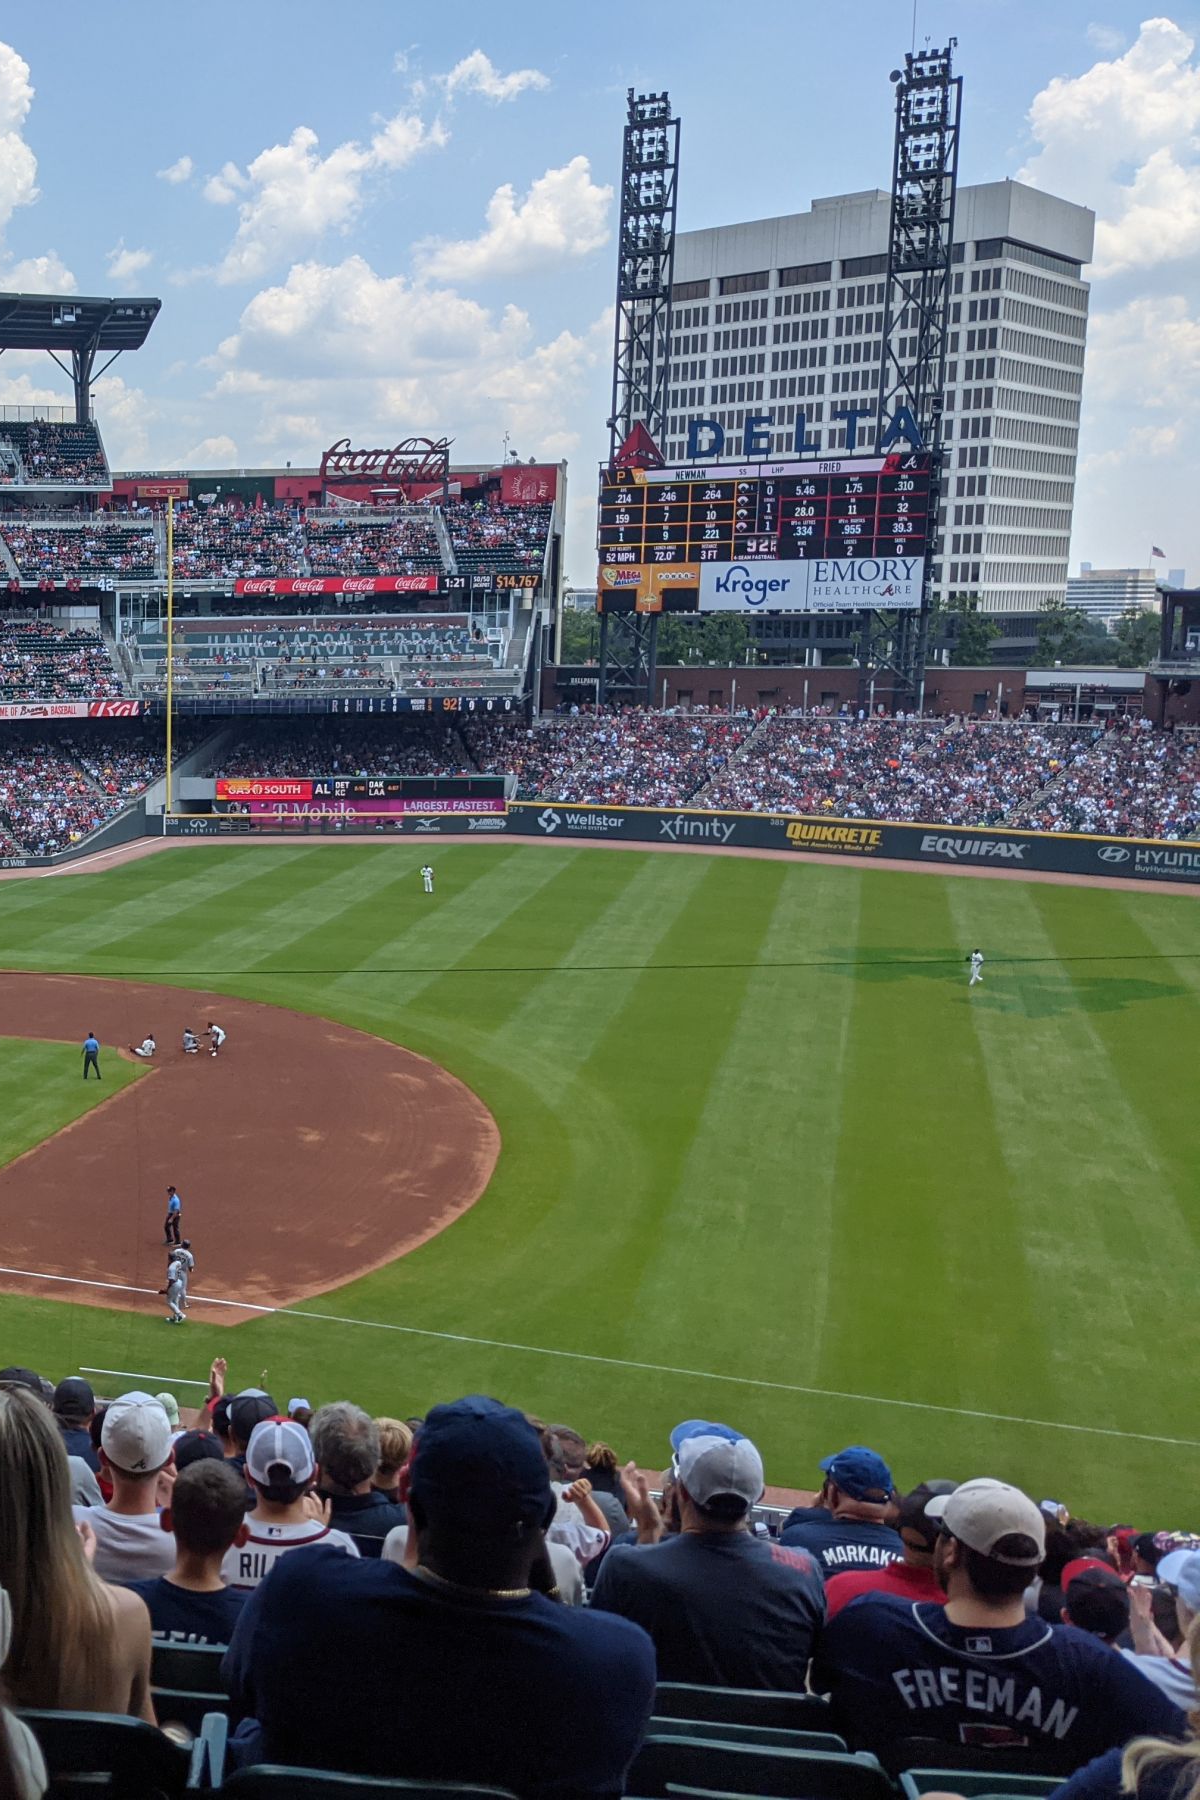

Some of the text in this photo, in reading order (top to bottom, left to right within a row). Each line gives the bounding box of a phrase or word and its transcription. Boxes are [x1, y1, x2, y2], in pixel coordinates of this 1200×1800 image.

[687, 405, 922, 458] DELTA
[771, 462, 841, 474] LHP FRIED
[675, 469, 706, 480] NEWMAN
[766, 486, 773, 495] 0
[796, 486, 815, 495] 5.46
[845, 484, 862, 493] 1.75
[894, 481, 914, 490] .310
[616, 494, 632, 504] .214
[659, 492, 676, 502] .246
[703, 490, 721, 500] .264
[766, 504, 771, 512] 1
[794, 506, 814, 516] 28.0
[848, 505, 856, 514] 11
[897, 503, 908, 512] 32
[616, 514, 630, 524] 159
[664, 512, 669, 522] 7
[706, 511, 716, 520] 10
[765, 521, 770, 530] 1
[842, 524, 861, 534] .955
[892, 522, 912, 533] 39.3
[663, 532, 668, 540] 9
[703, 530, 720, 539] .221
[792, 526, 812, 536] .334
[619, 532, 624, 542] 1
[747, 537, 768, 552] 92
[896, 545, 902, 554] 0
[700, 550, 718, 560] 3 FT
[799, 548, 804, 557] 1
[847, 546, 852, 556] 2
[606, 552, 636, 562] 52 MPH
[616, 570, 641, 580] MEGA
[814, 558, 919, 582] EMORY
[98, 579, 114, 592] 42
[444, 578, 465, 588] 1:21
[497, 574, 539, 588] $14,767
[716, 566, 790, 605] Kroger
[814, 584, 912, 596] HEALTHCARE
[208, 634, 265, 656] HANK
[332, 700, 338, 712] R
[356, 700, 362, 712] H
[380, 700, 386, 712] E
[443, 698, 458, 710] 92
[11, 707, 18, 716] OF
[51, 706, 76, 715] BASEBALL
[228, 784, 300, 794] GAS SOUTH
[315, 784, 330, 794] AL
[404, 800, 496, 810] LARGEST. FASTEST.
[292, 800, 356, 822] Mobile
[566, 813, 624, 827] Wellstar
[770, 818, 785, 826] 385
[659, 814, 736, 843] xfinity
[786, 822, 882, 845] QUIKRETE
[811, 841, 842, 849] America's
[920, 835, 1024, 859] EQUIFAX
[892, 1667, 1079, 1740] FREEMAN
